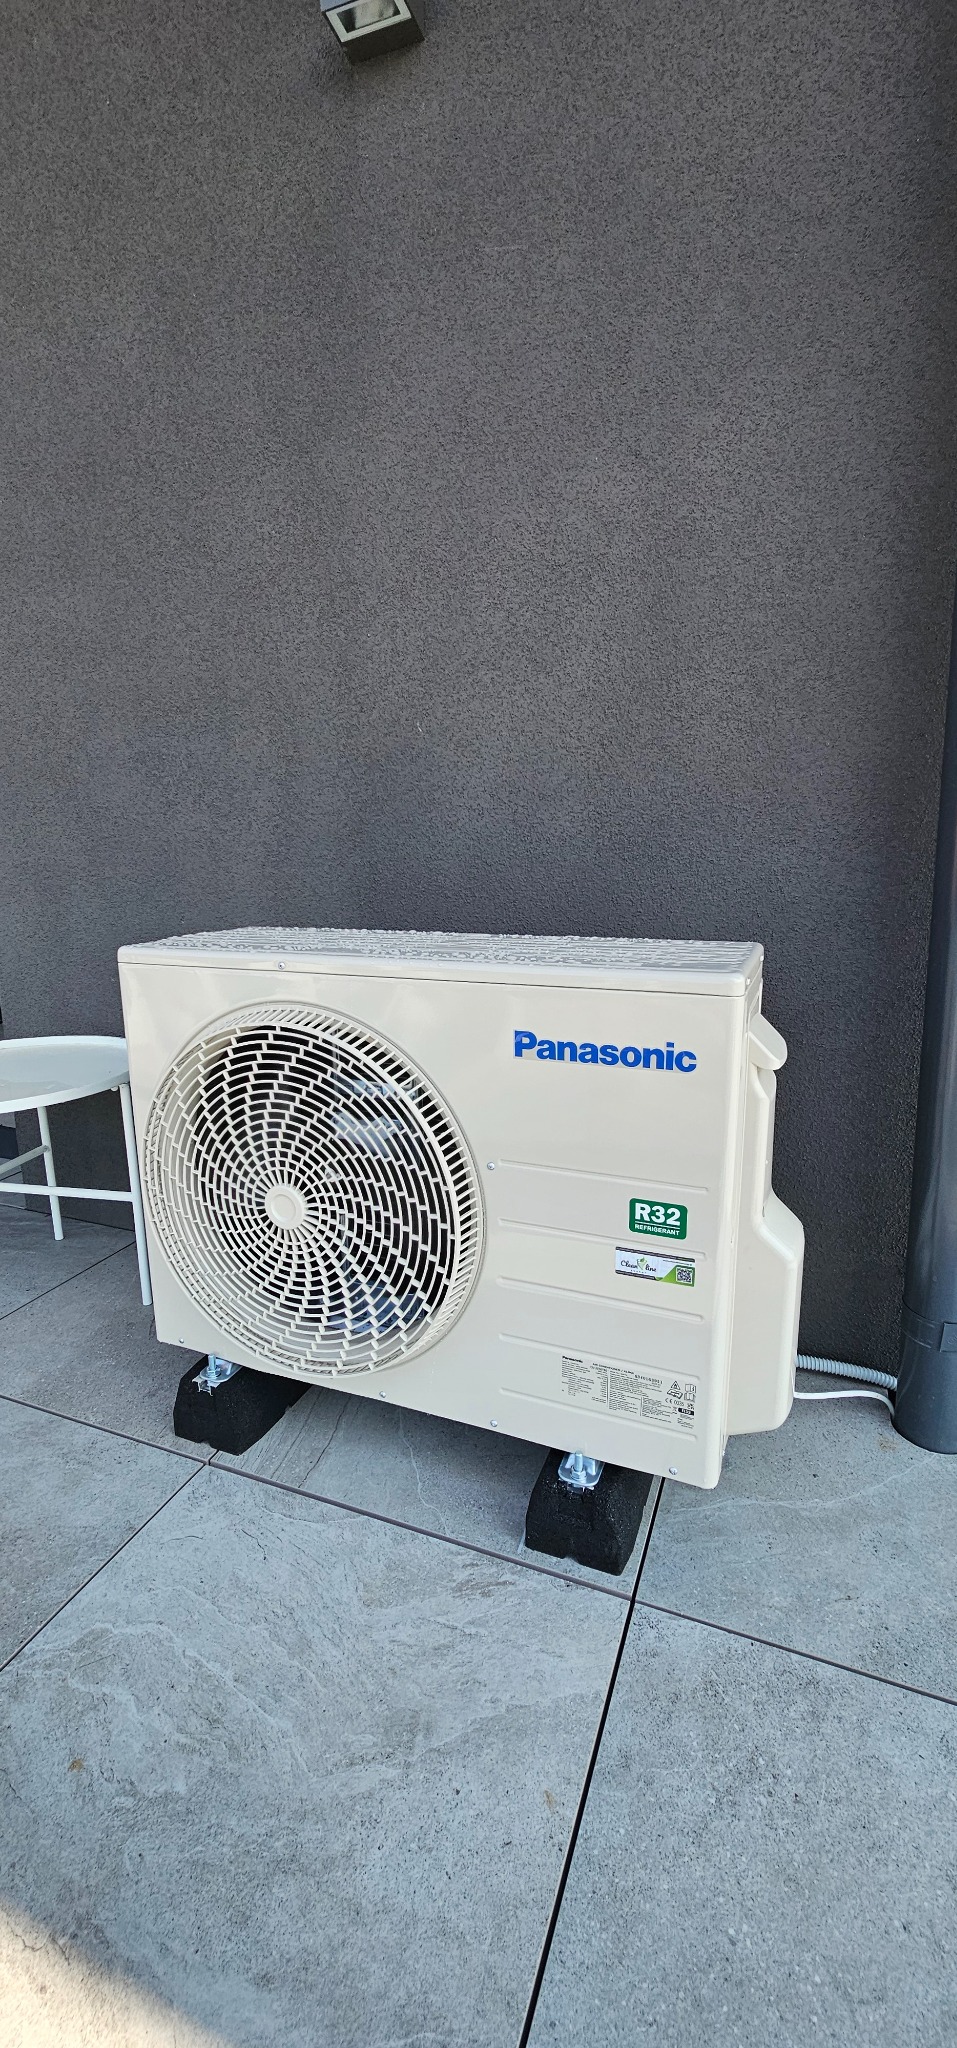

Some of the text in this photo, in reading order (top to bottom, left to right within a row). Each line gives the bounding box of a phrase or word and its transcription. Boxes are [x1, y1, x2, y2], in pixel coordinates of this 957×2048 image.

[514, 1030, 697, 1073] Panasonic
[635, 1203, 681, 1226] R32
[634, 1224, 680, 1236] REFRIGERANT
